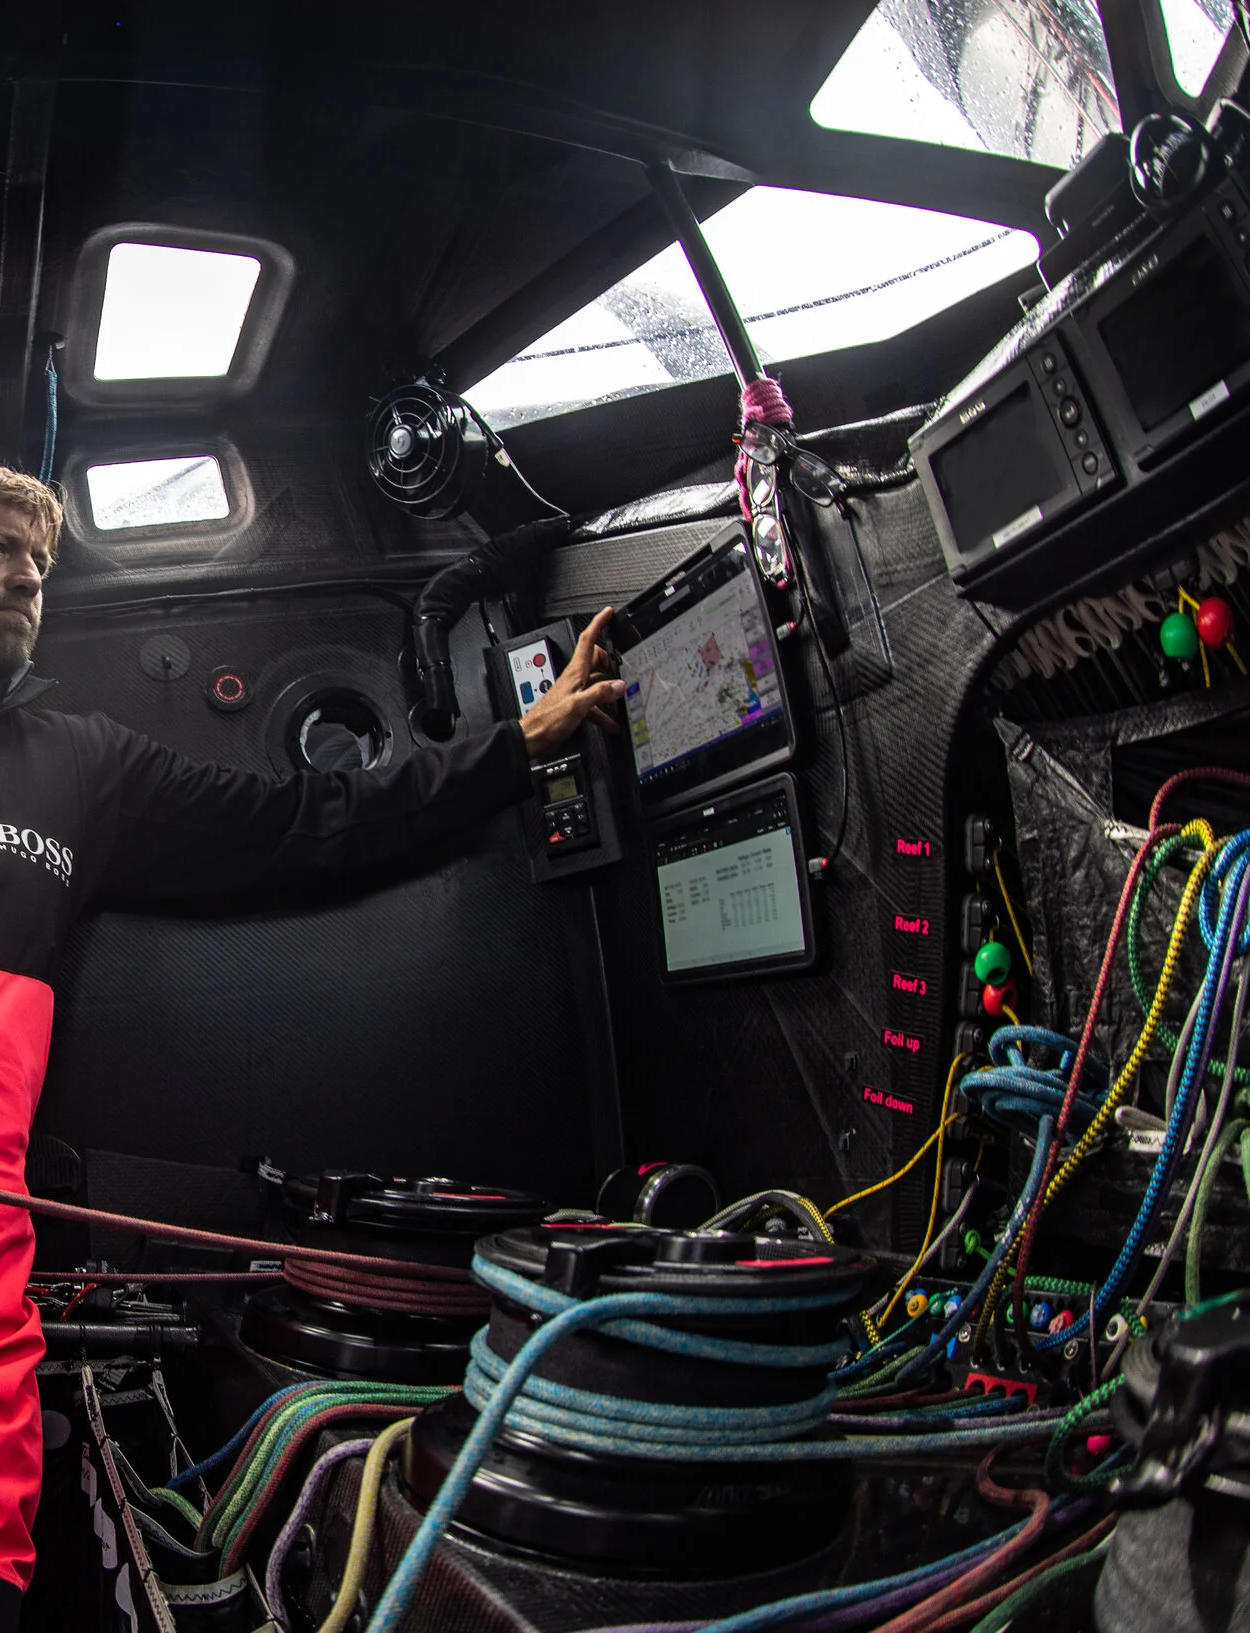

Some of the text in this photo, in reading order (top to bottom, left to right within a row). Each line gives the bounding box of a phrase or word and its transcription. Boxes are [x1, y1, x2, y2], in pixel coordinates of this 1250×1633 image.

[0, 844, 37, 863] HUGO
[897, 839, 930, 857] Reef 1
[895, 916, 929, 935] Reef 2
[893, 974, 927, 995] Reef 3
[884, 1030, 920, 1053] Foil up
[864, 1087, 913, 1114] Foil down
